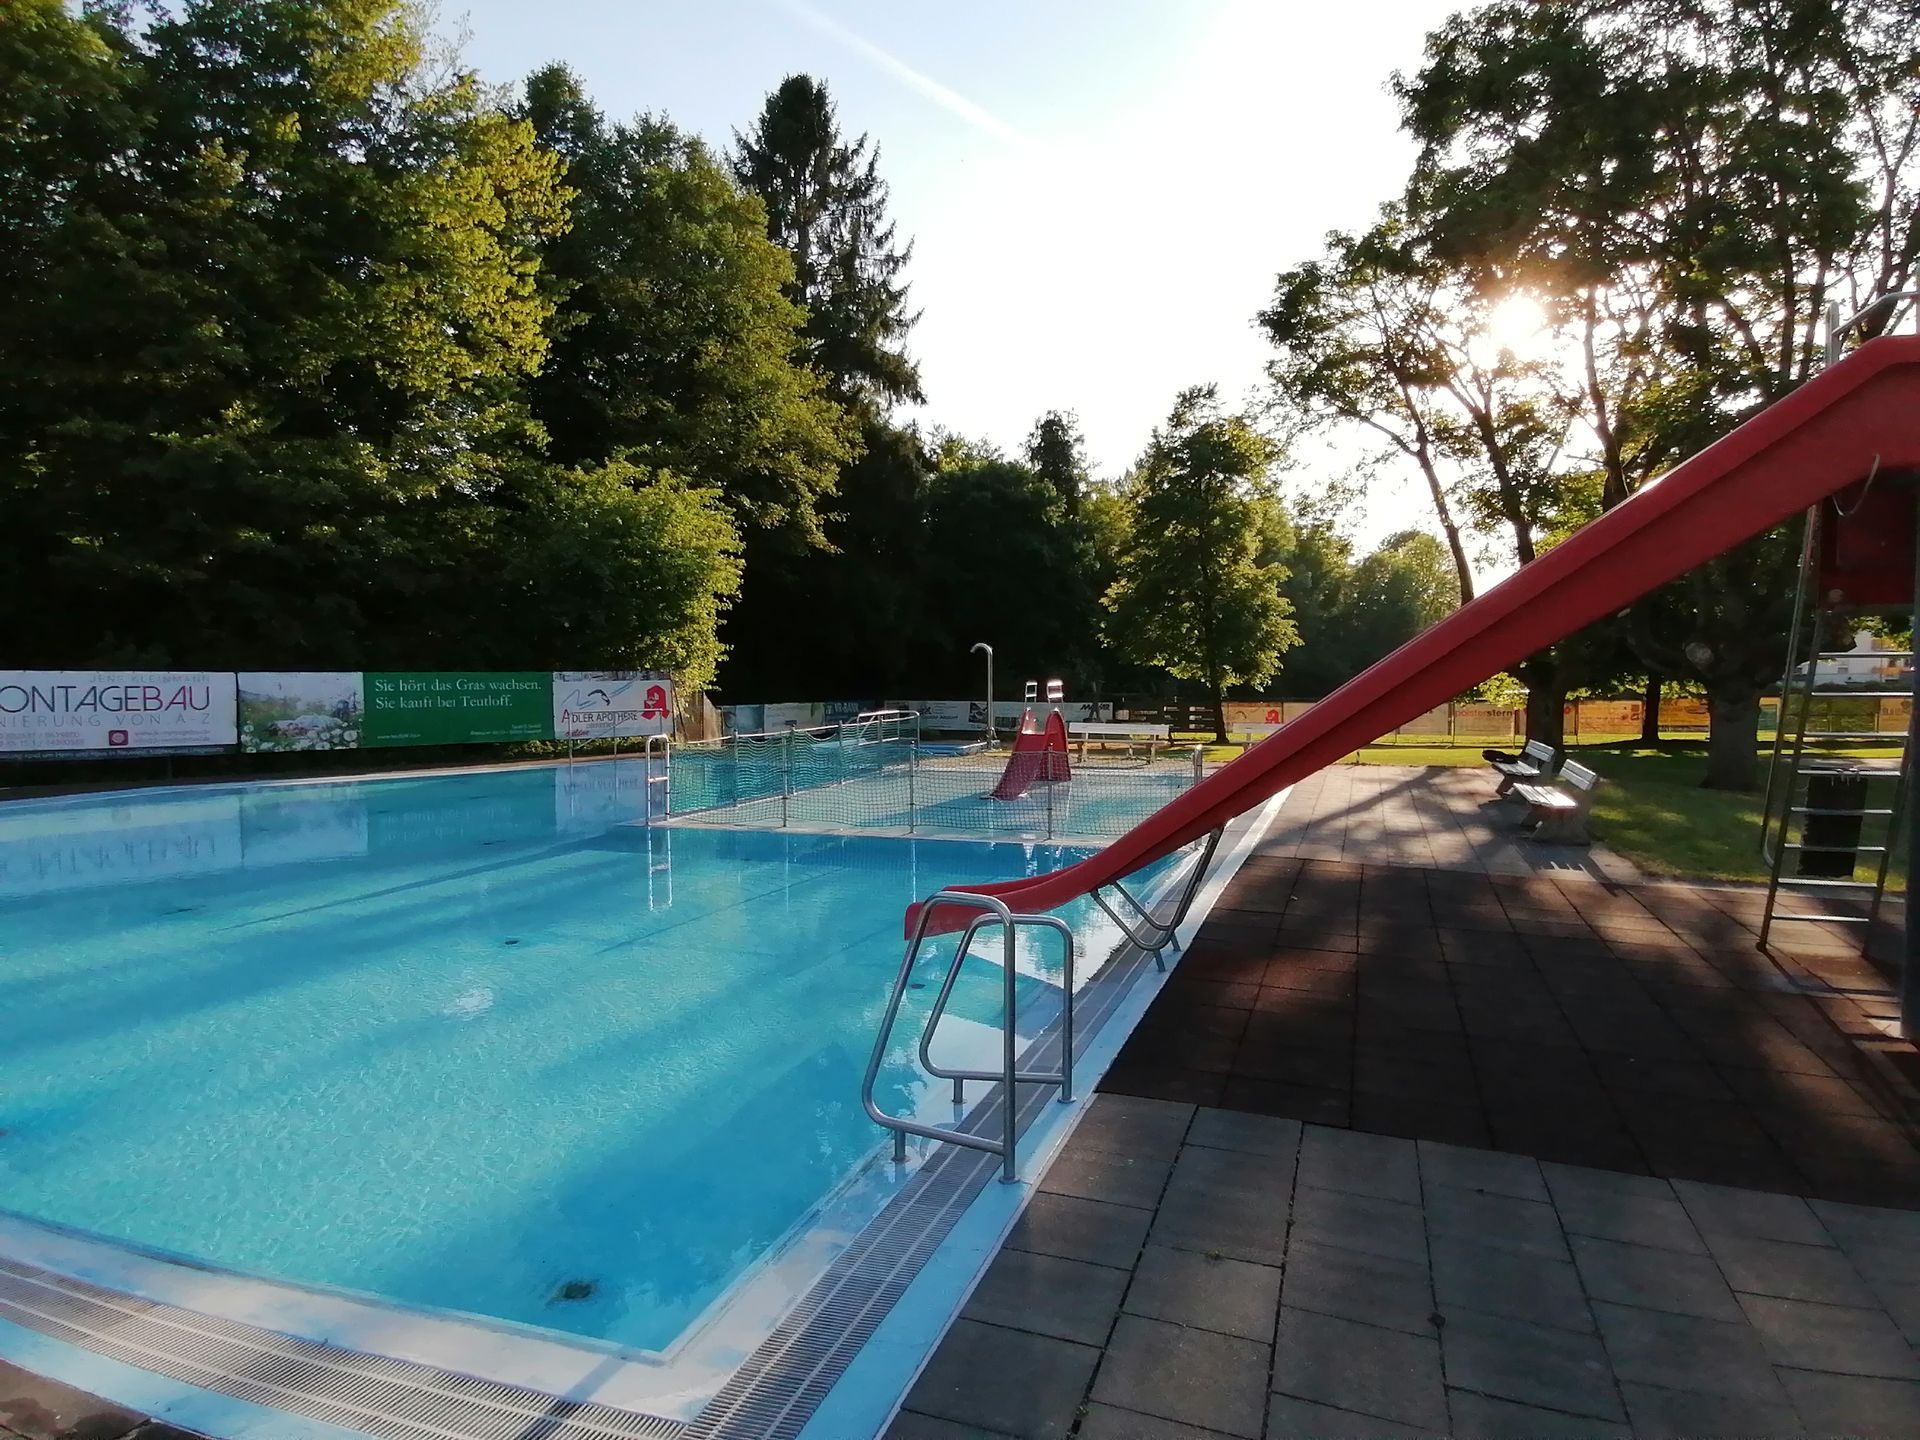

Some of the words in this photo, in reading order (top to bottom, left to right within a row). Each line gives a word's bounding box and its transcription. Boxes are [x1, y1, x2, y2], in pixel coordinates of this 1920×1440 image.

[375, 679, 395, 692] Sie
[400, 679, 427, 691] hört
[431, 678, 452, 691] das
[456, 679, 486, 691] Gras
[489, 679, 542, 690] wachsen.
[375, 697, 396, 710] Sie
[400, 696, 433, 709] kauft
[437, 695, 456, 708] bei
[460, 694, 513, 707] Teutloff.
[116, 713, 161, 726] VON
